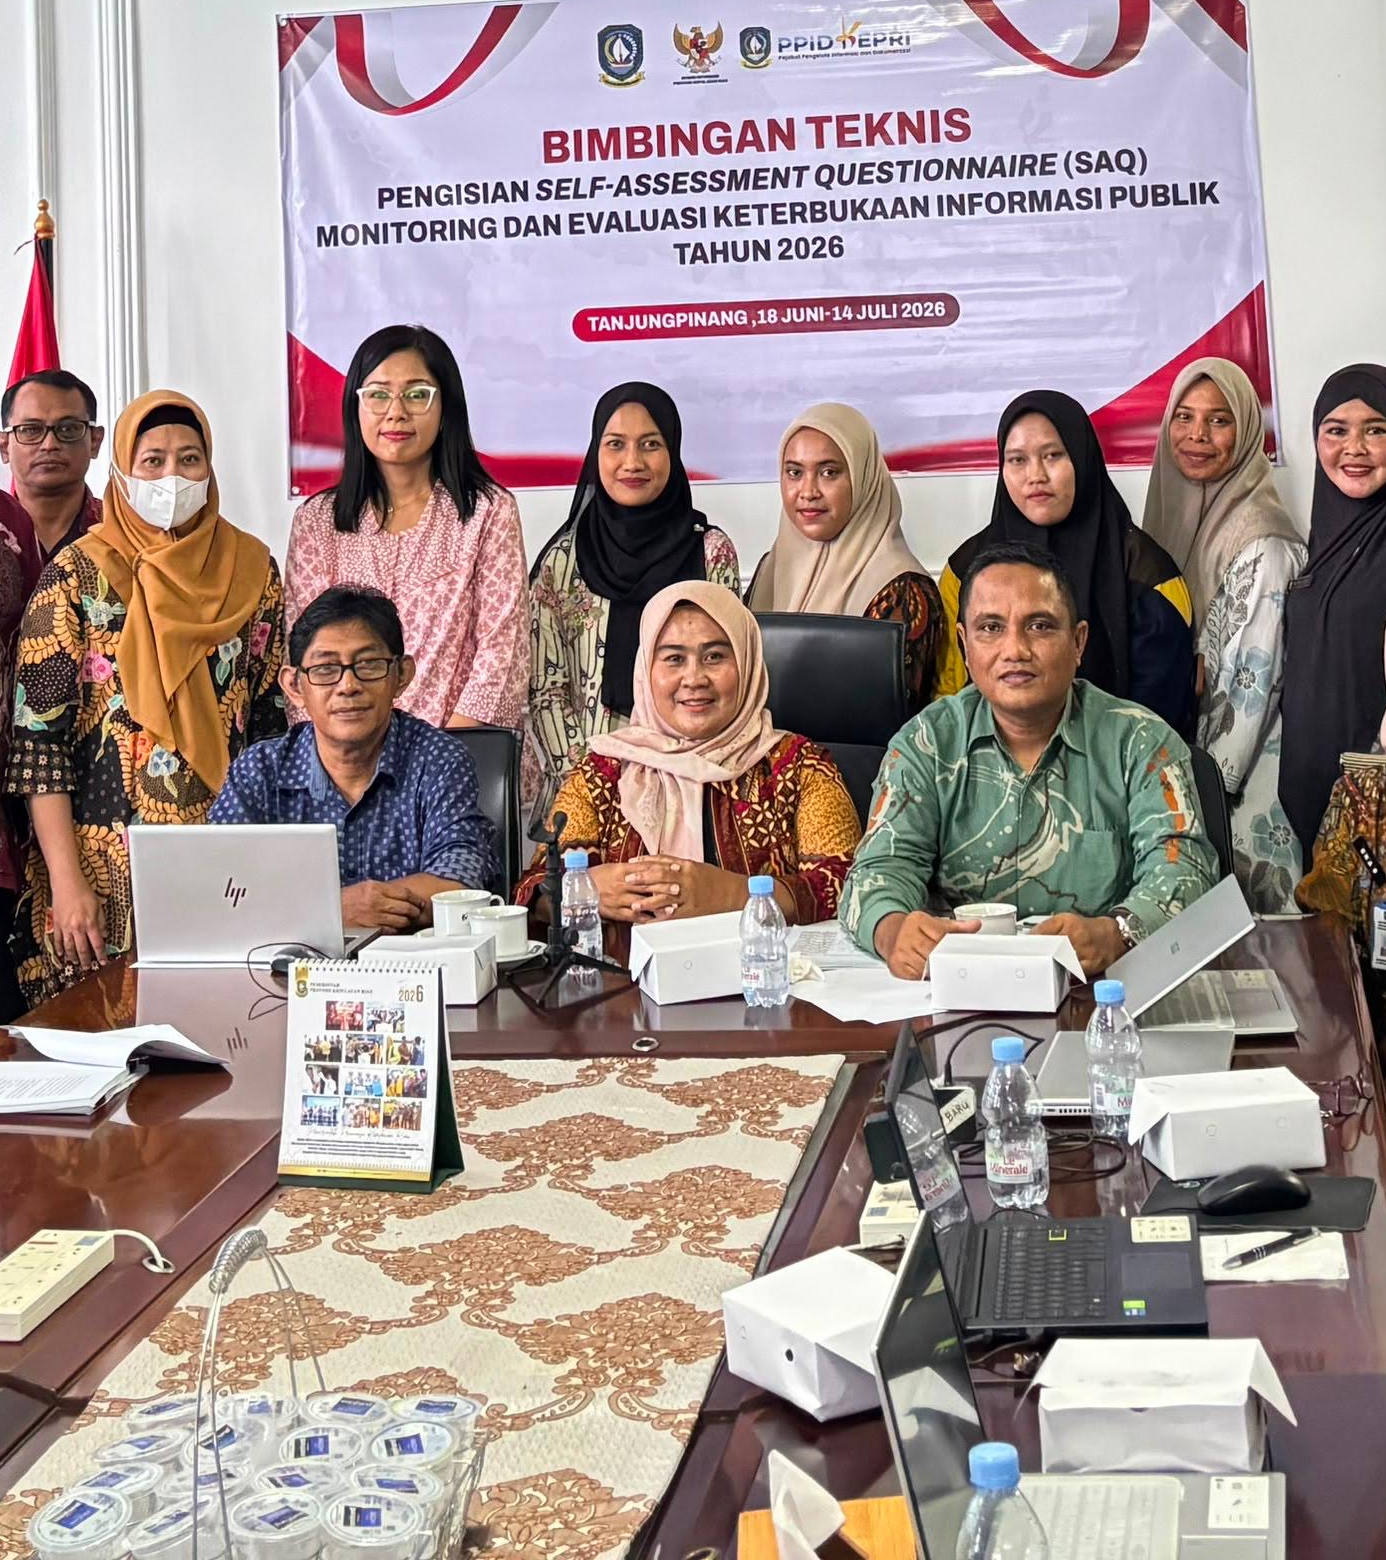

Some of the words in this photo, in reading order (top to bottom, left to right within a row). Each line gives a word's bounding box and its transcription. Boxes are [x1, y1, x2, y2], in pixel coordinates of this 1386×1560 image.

[778, 35, 833, 53] PPID
[542, 117, 797, 164] BIMBINGAN
[805, 107, 972, 149] TEKNIS
[377, 180, 530, 209] PENGISIAN
[535, 165, 811, 202] SELF-ASSESSMENT
[814, 151, 1059, 191] QUESTIONNAIRE
[1063, 147, 1148, 180] (SAQ)
[316, 217, 498, 248] MONITORING
[503, 213, 562, 239] DAN
[568, 205, 707, 236] EVALUASI
[714, 195, 931, 229] KETERBUKAAN
[936, 186, 1103, 218] INFORMASI
[1110, 181, 1220, 210] PUBLIK
[673, 239, 772, 266] TAHUN
[777, 234, 845, 262] 2026
[587, 308, 749, 333] TANJUNGPINANG
[751, 307, 779, 327] ,18
[780, 303, 854, 324] JUNI-14
[856, 302, 898, 321] JULI
[901, 300, 946, 319] 2026
[398, 984, 424, 1003] 2026
[945, 1101, 970, 1122] BARU
[989, 1162, 1029, 1176] Minerale
